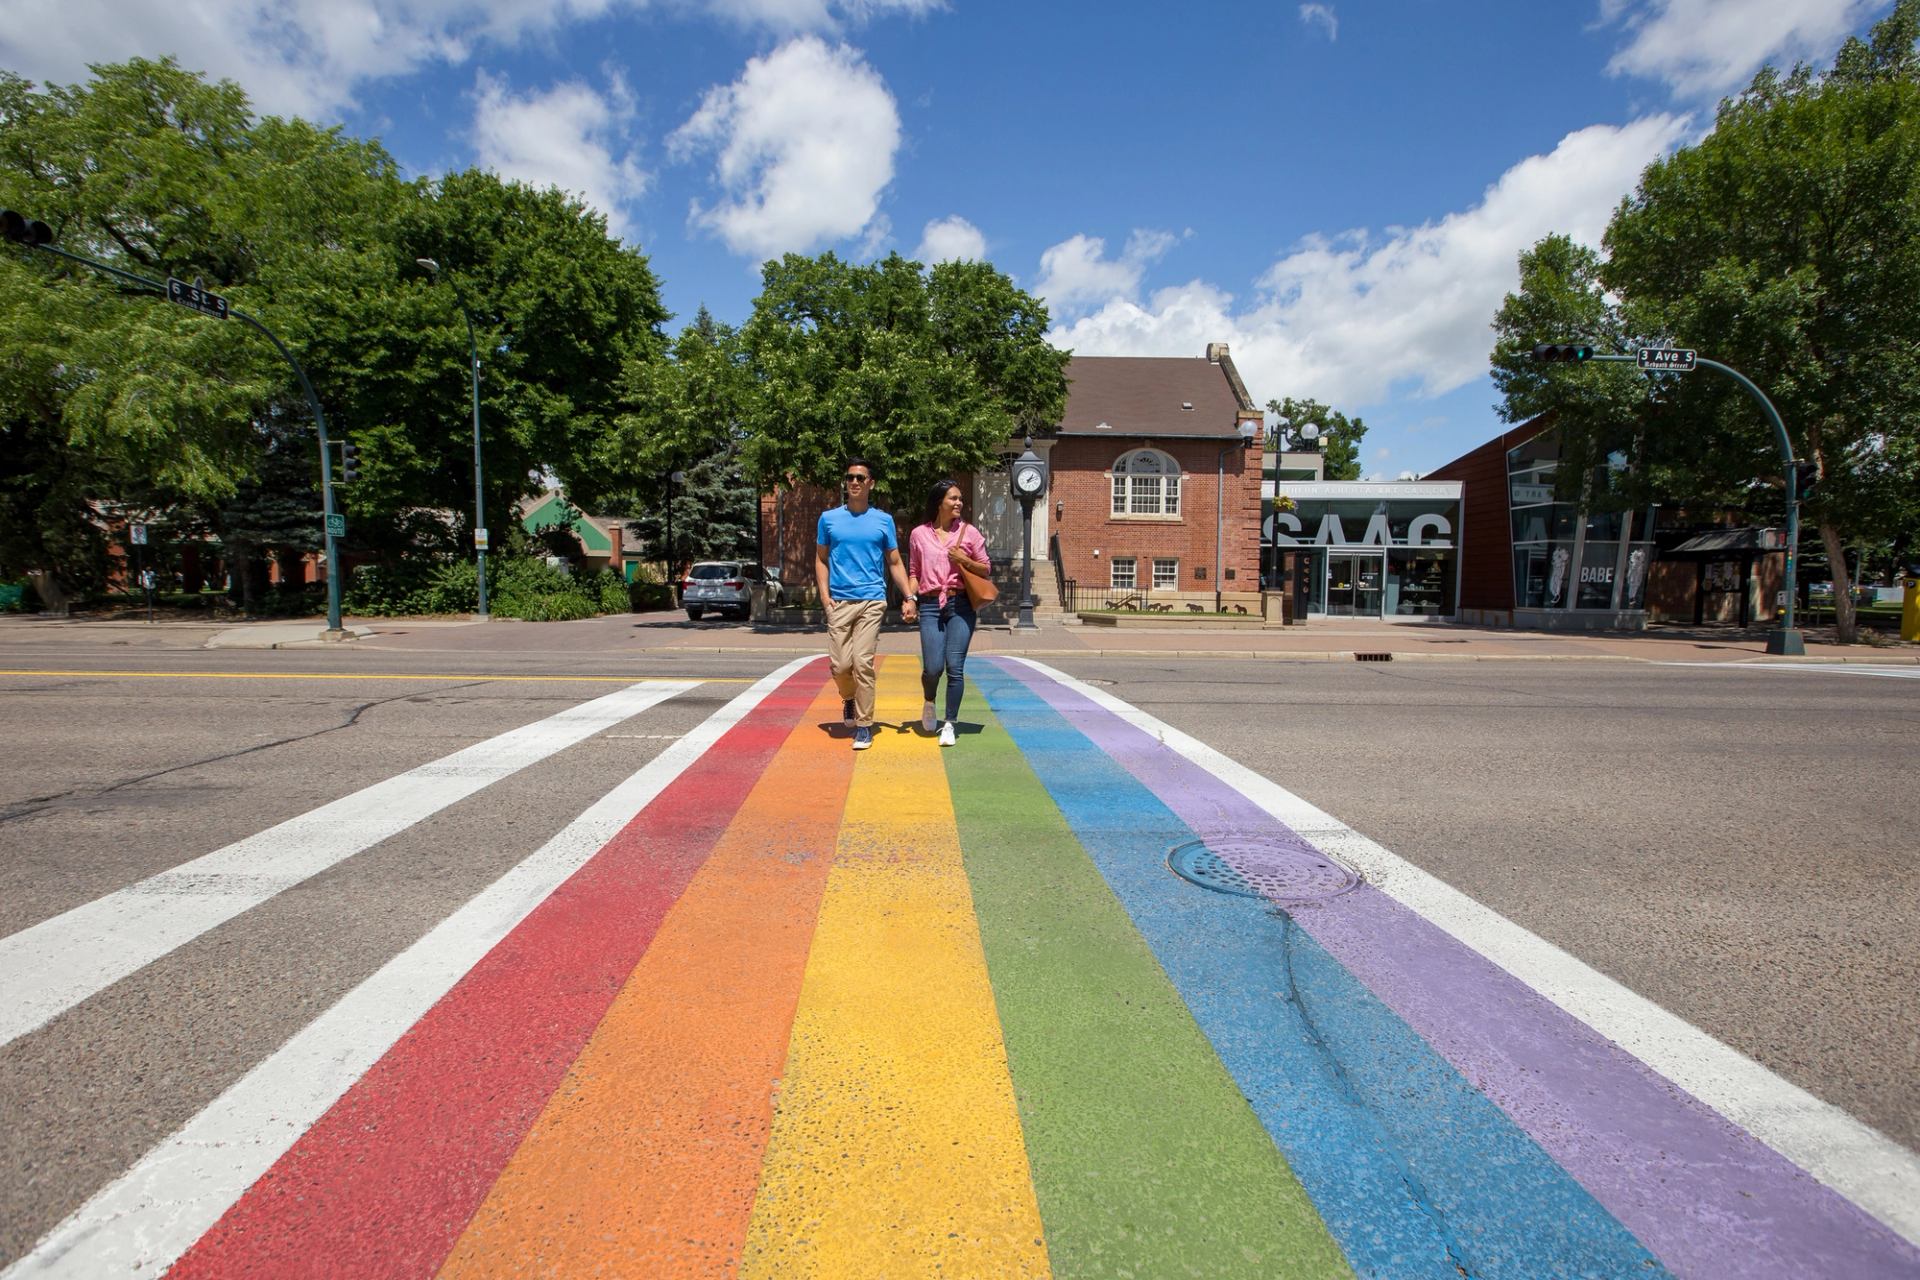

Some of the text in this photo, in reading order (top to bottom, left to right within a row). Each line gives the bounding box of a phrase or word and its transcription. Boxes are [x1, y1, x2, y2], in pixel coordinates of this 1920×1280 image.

[172, 283, 181, 294] 6
[217, 299, 225, 310] S
[1641, 350, 1694, 362] 3 Ave S
[1262, 513, 1452, 546] SAAG
[1580, 567, 1614, 583] BABE
